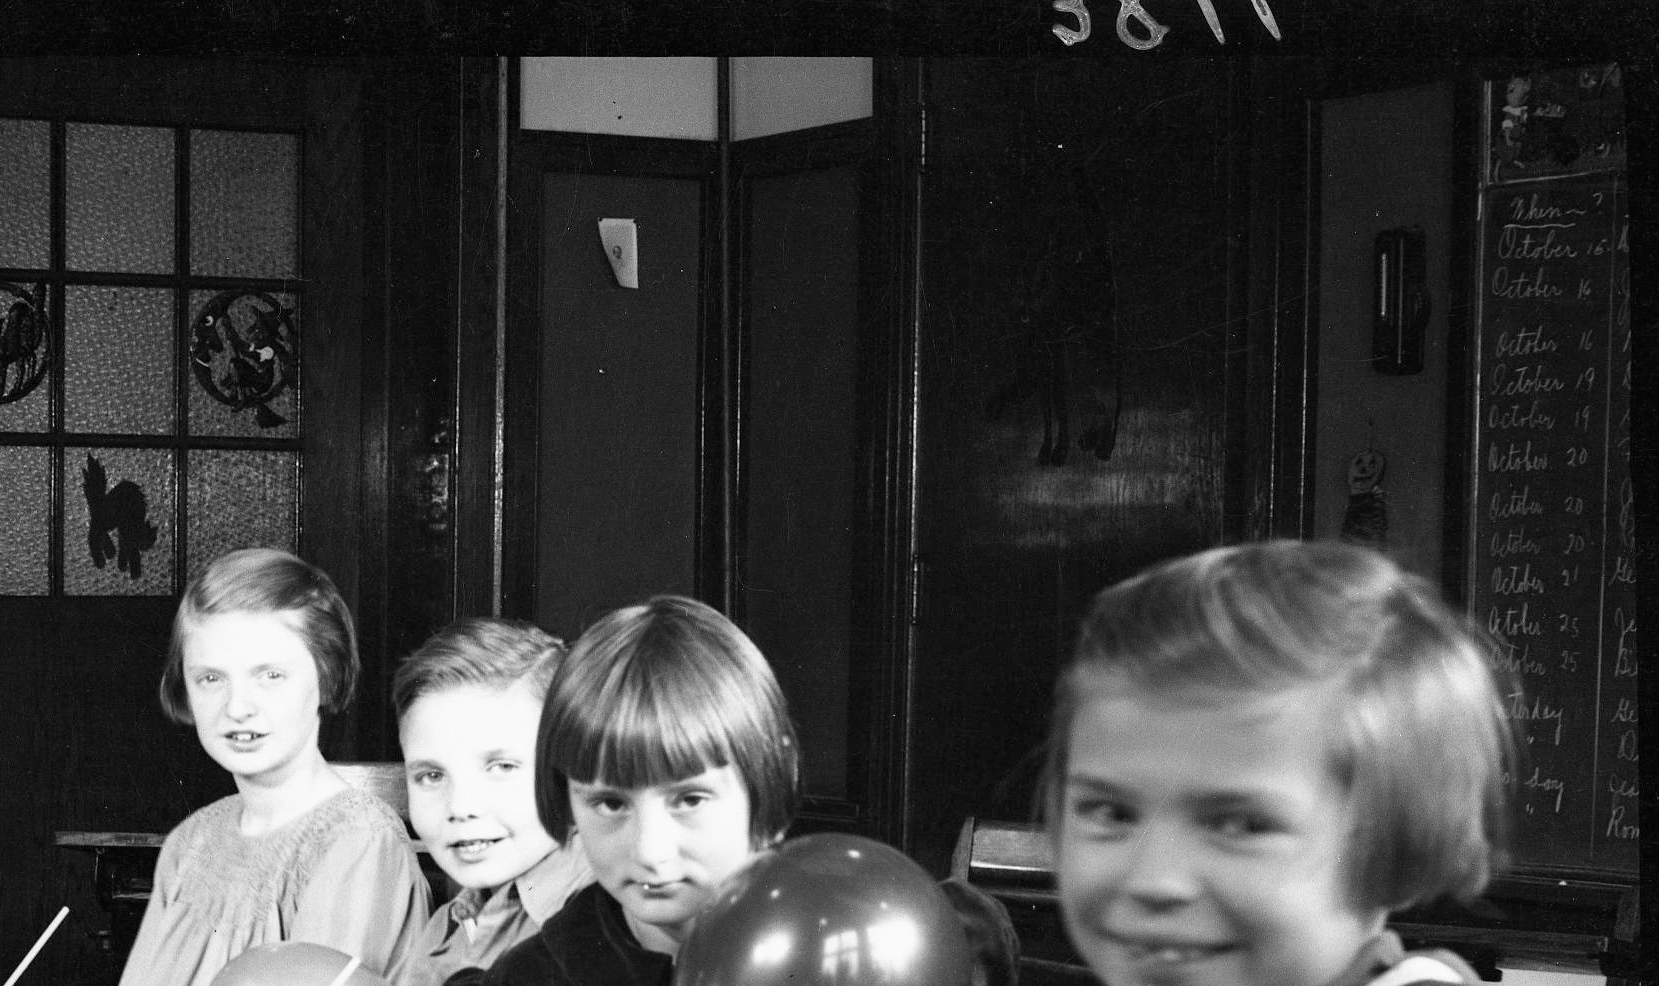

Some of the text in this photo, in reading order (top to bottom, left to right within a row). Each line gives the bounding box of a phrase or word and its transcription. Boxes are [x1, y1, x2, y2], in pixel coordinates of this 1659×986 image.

[1498, 226, 1578, 260] October
[1492, 265, 1563, 298] October
[1495, 324, 1558, 358] October
[1490, 363, 1565, 397] October
[1574, 367, 1596, 392] 19
[1488, 401, 1591, 433] October 19
[1488, 439, 1588, 473] October 20
[1488, 485, 1544, 522] October
[1489, 527, 1541, 558] October
[1491, 563, 1545, 596] October
[1488, 602, 1543, 637] October
